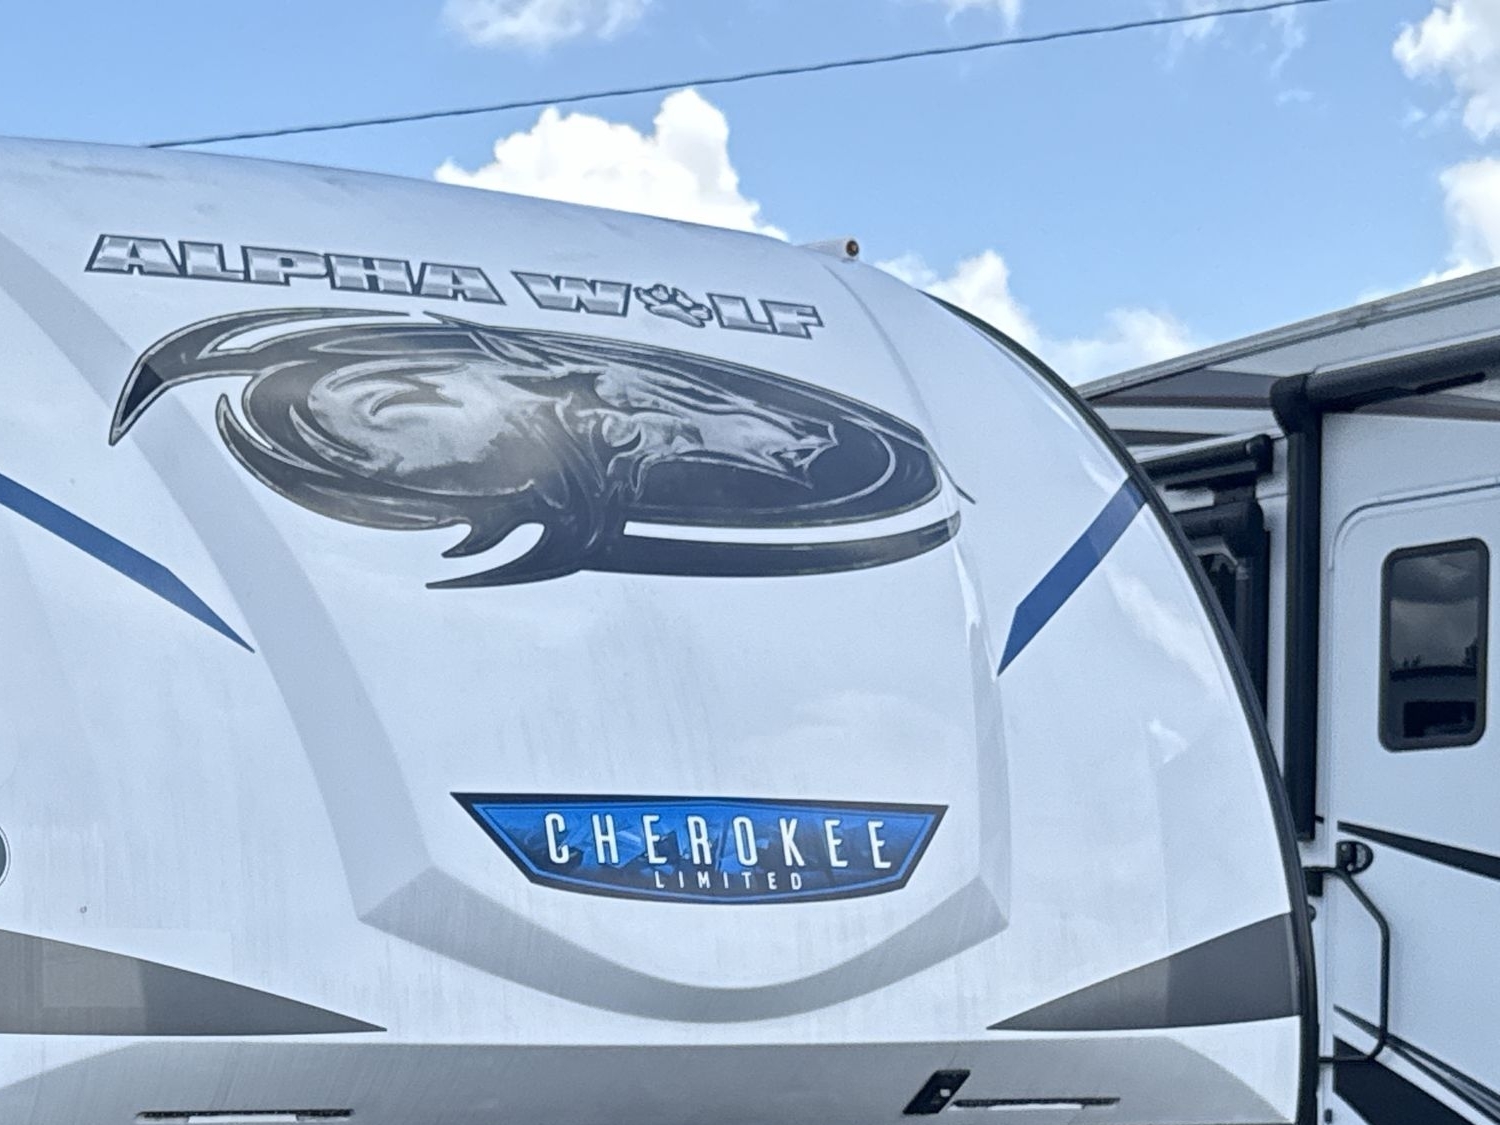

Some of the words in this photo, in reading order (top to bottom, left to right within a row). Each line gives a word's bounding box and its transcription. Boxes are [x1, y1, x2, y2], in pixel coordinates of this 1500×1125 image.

[86, 233, 506, 305] ALPHA
[544, 812, 892, 869] CHEROKEE
[654, 869, 802, 891] LIMITED
